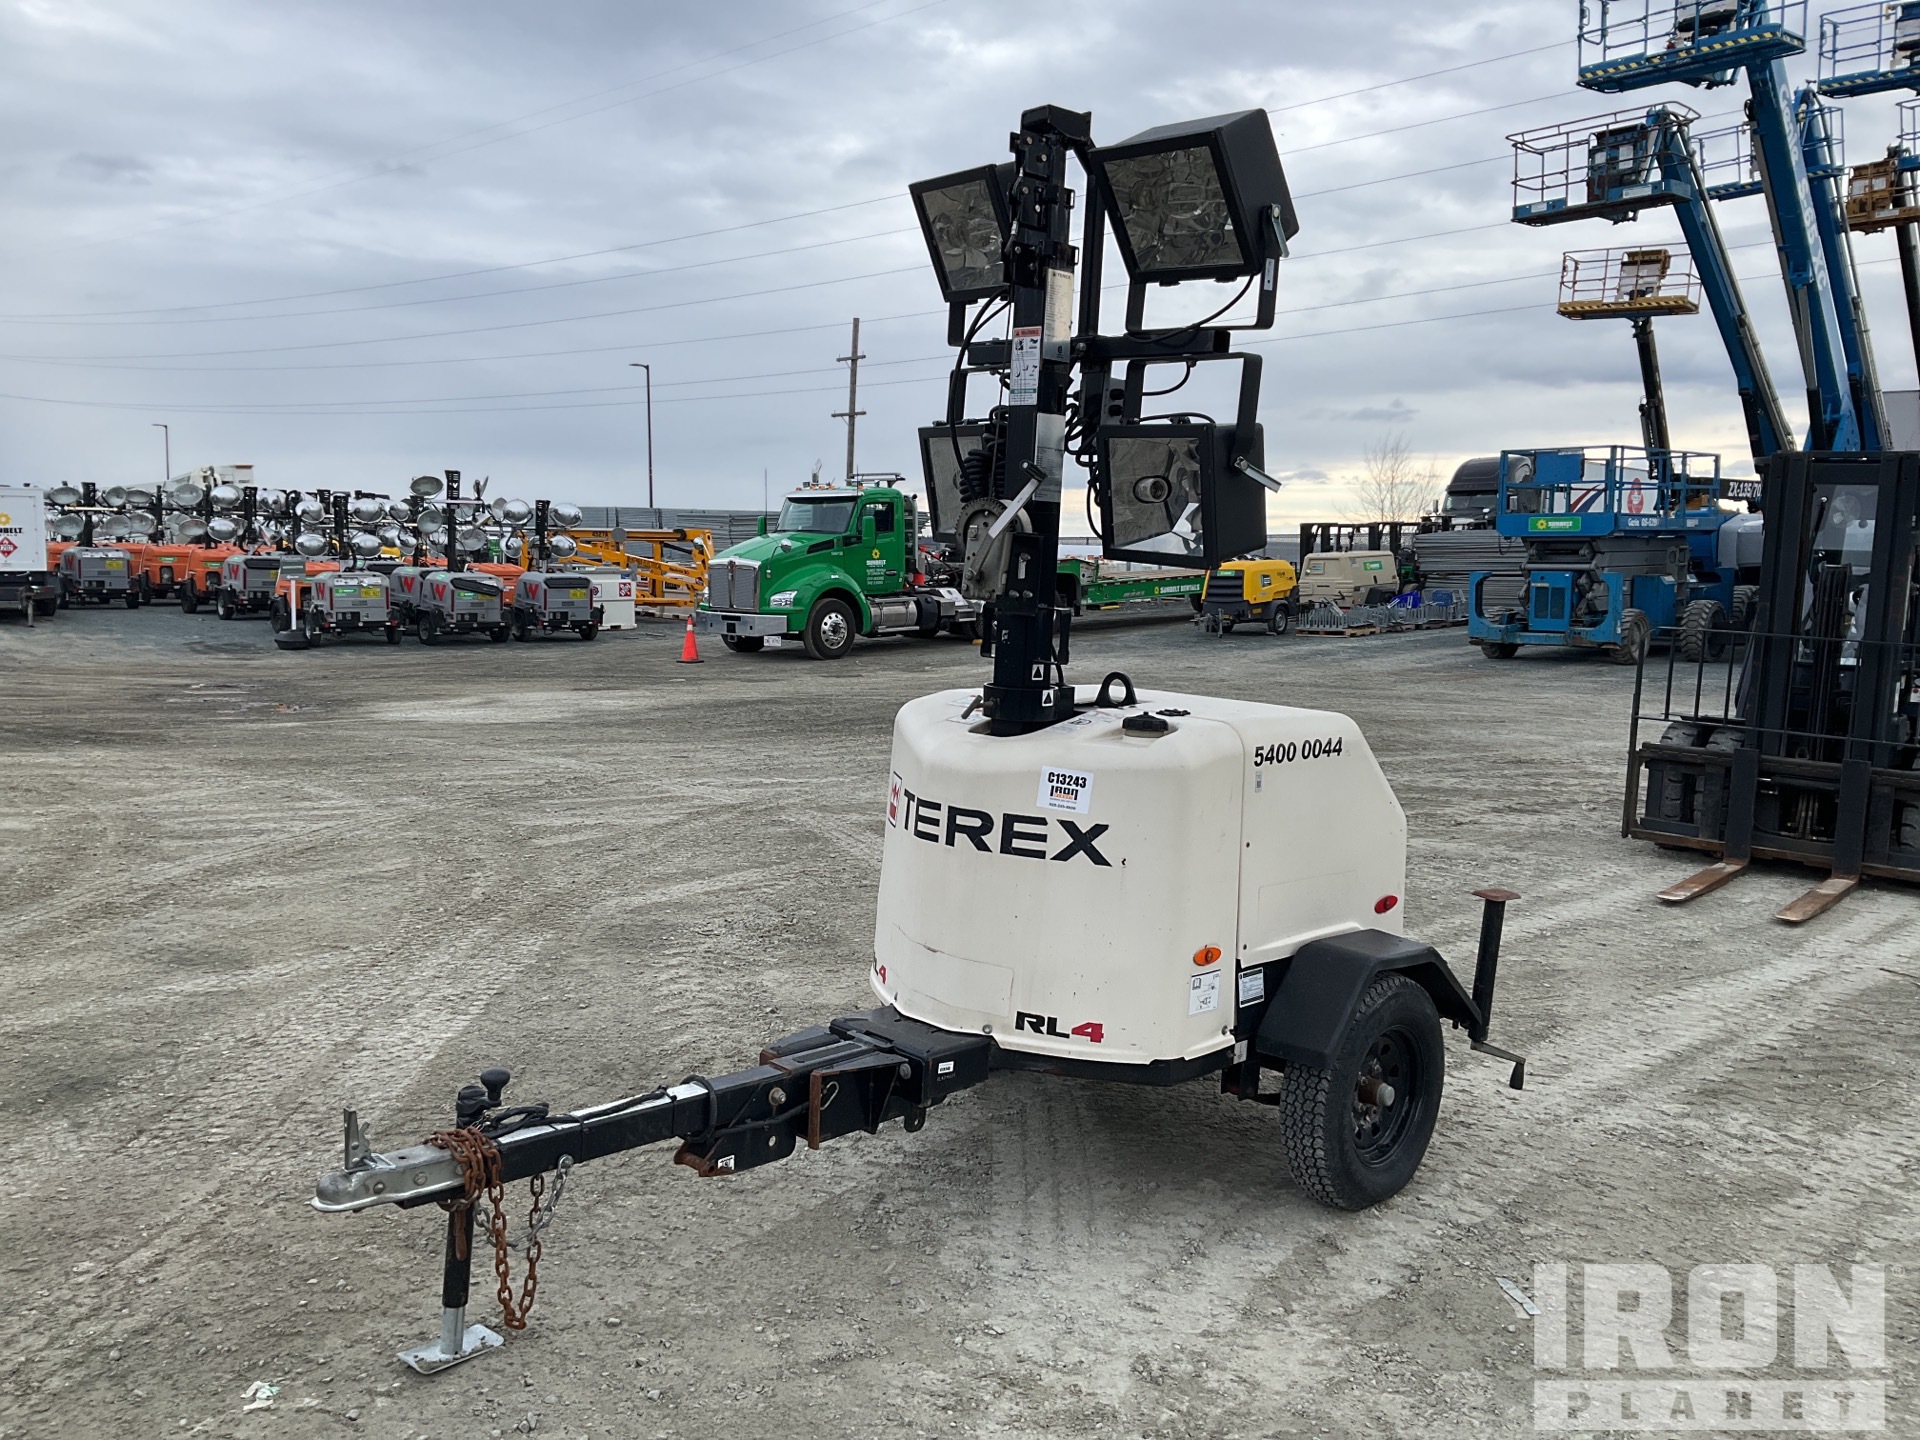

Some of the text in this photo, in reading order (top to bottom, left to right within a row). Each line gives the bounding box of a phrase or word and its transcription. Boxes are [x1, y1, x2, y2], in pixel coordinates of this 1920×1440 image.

[1798, 177, 1818, 245] S-65
[1811, 253, 1827, 291] XC
[1253, 736, 1343, 767] 5400 0044
[1047, 771, 1087, 789] C13243
[1050, 785, 1079, 800] IRON
[903, 788, 1112, 868] TEREX
[1014, 1010, 1104, 1043] RL4
